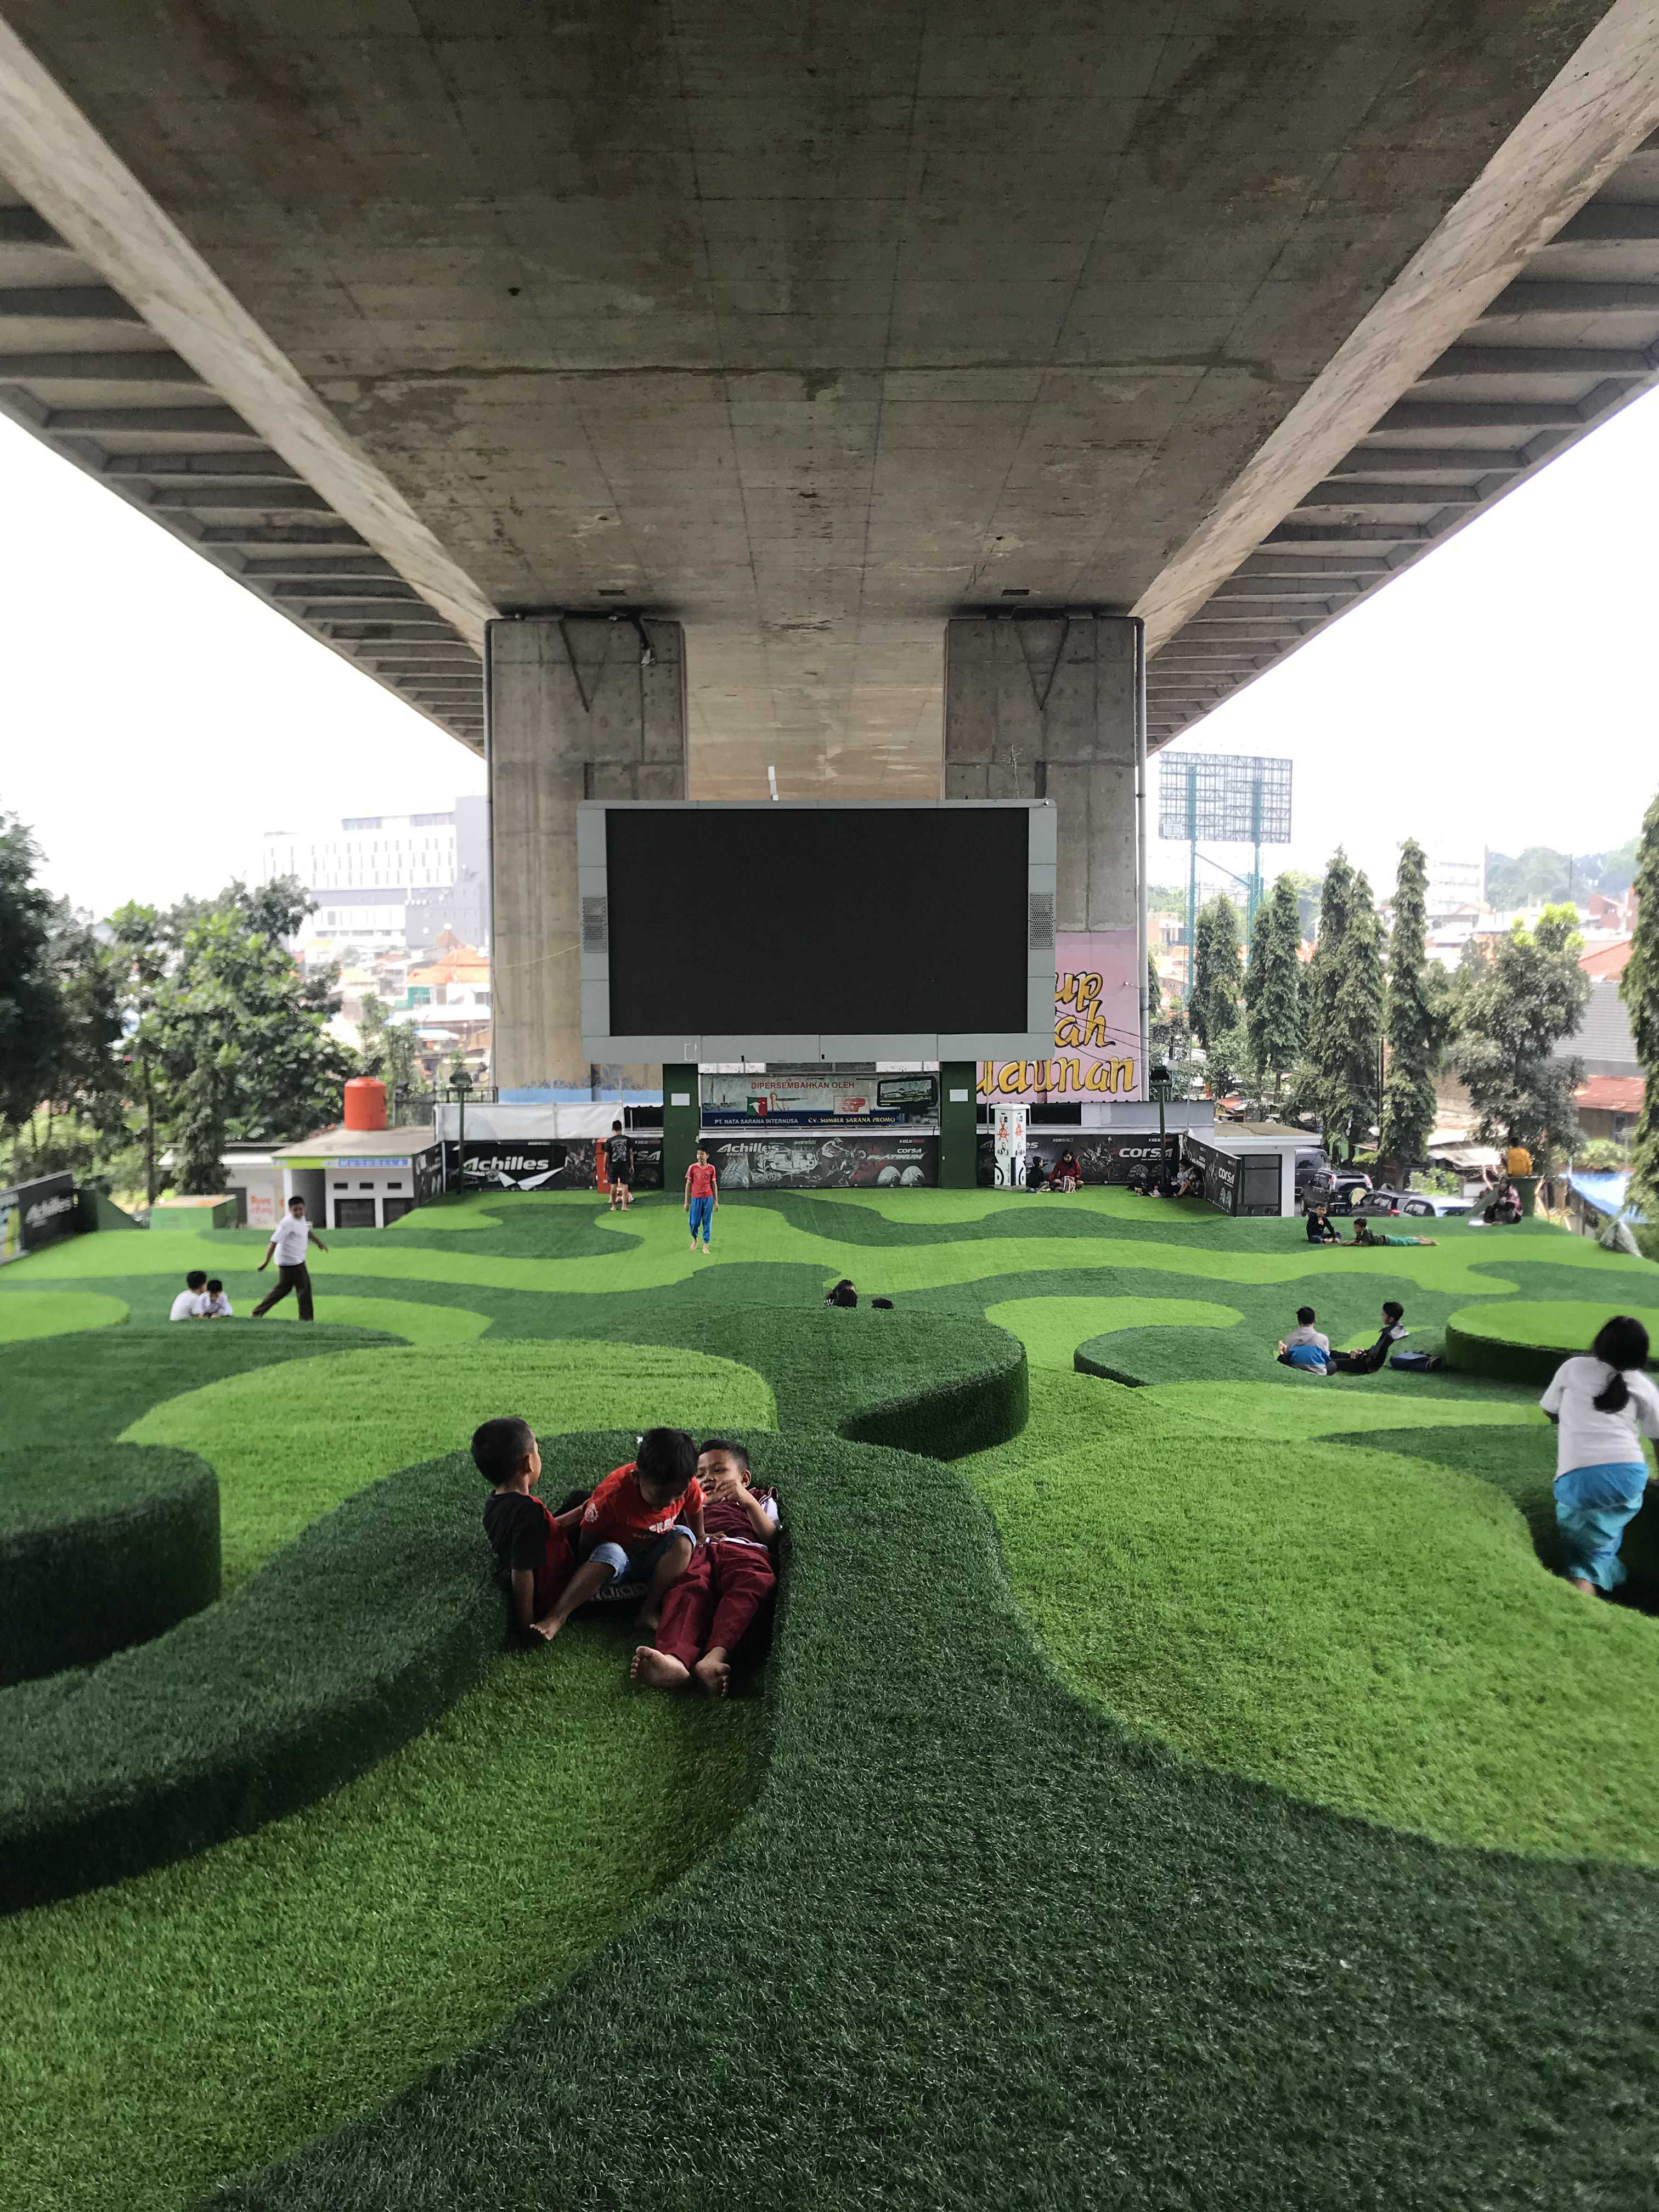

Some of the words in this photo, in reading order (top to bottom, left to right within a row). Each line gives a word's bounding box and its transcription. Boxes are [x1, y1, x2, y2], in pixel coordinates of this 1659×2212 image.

[1054, 971, 1103, 1013] up
[1054, 1000, 1116, 1048] ah
[716, 1143, 780, 1153] Achilles
[463, 1156, 549, 1171] Achilles
[867, 1153, 926, 1161] PLATINUM
